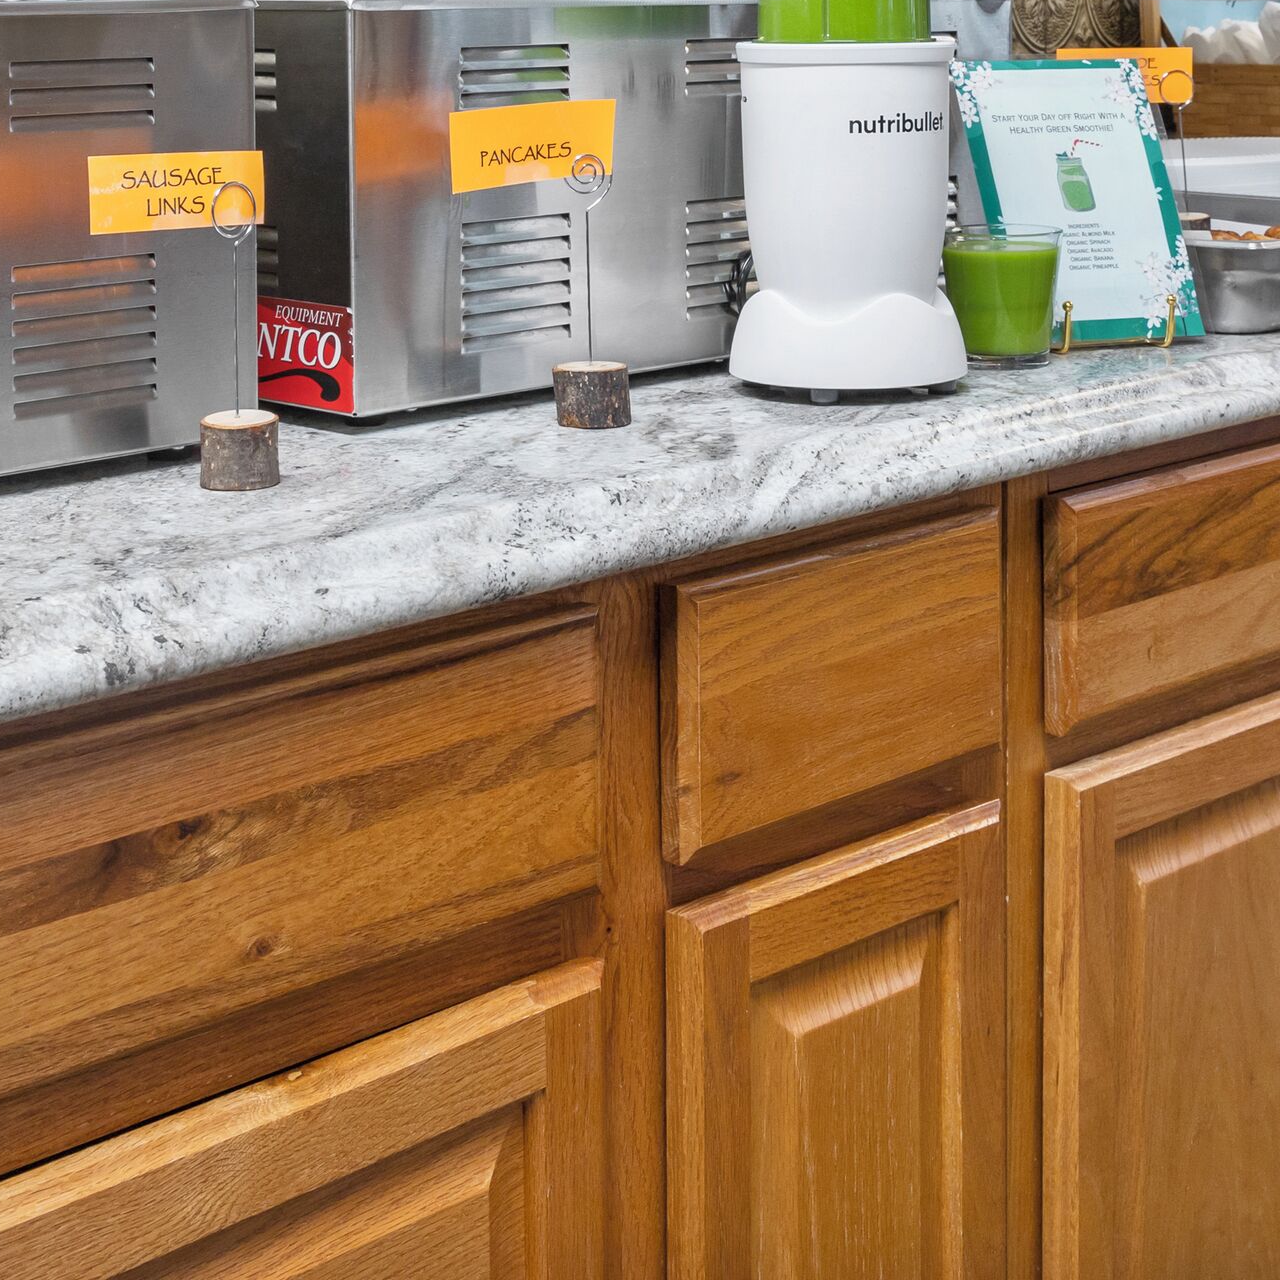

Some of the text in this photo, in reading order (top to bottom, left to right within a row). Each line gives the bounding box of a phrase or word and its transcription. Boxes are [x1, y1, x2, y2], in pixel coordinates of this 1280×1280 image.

[849, 111, 943, 134] nutribullet
[480, 141, 572, 167] PANCAKES
[121, 167, 226, 190] SAUSAGE
[146, 196, 206, 217] LINKS
[275, 304, 344, 327] EQUIPMENT
